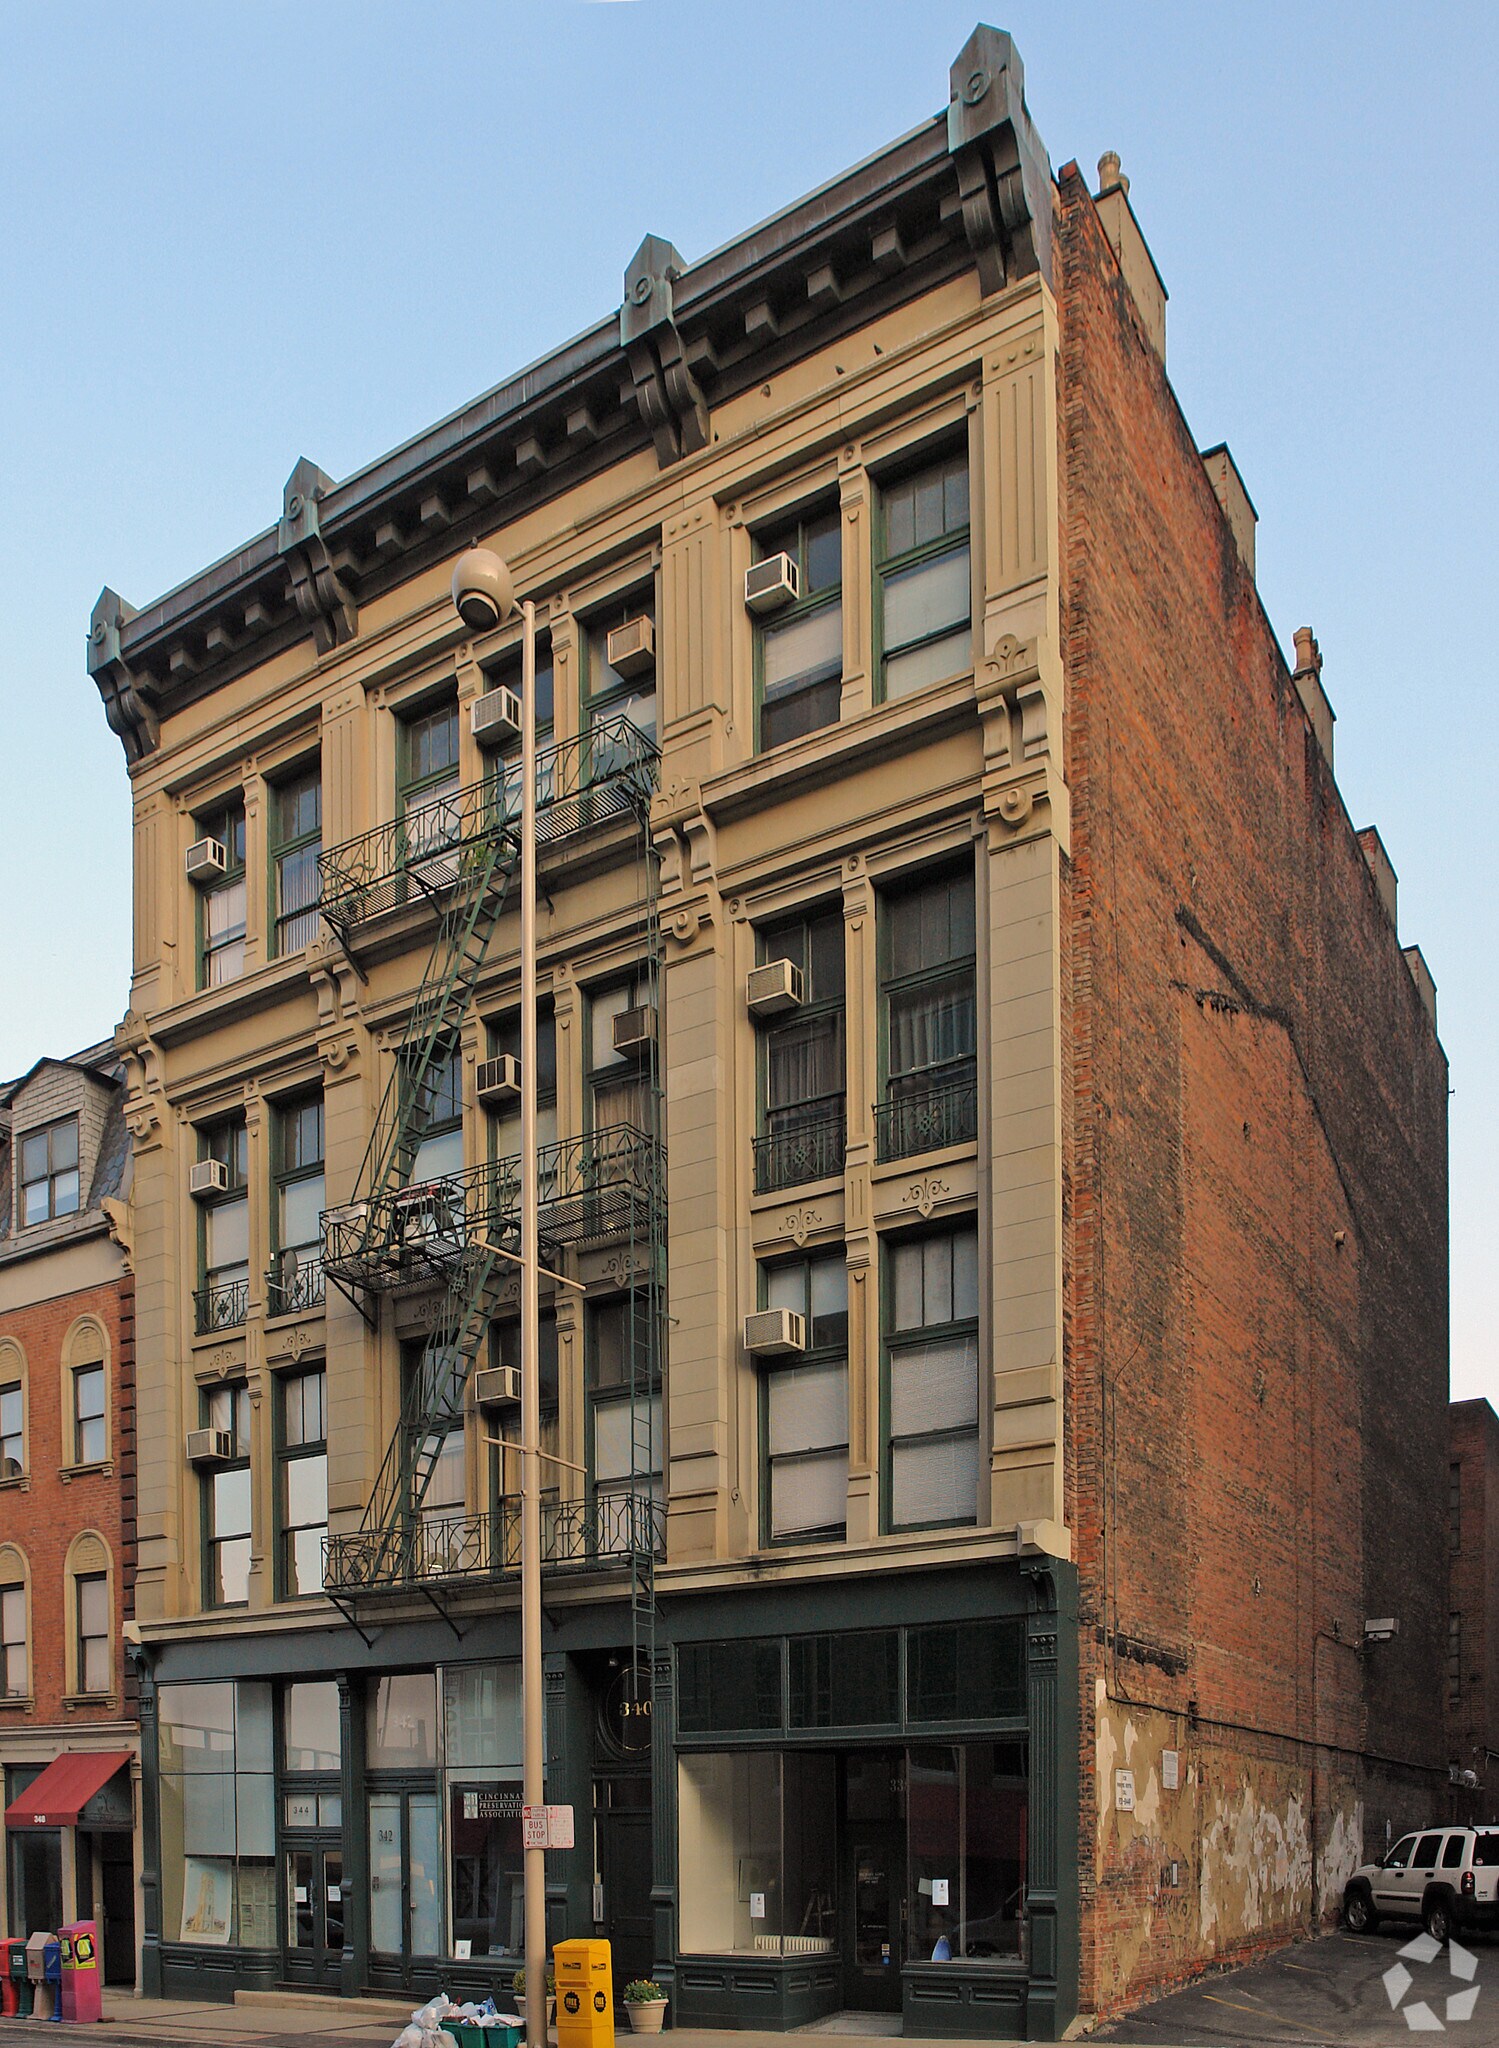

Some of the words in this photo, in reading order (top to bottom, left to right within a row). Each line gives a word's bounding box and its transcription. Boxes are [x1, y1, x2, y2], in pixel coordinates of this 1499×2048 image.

[619, 1701, 652, 1717] 340
[890, 1779, 907, 1792] 33
[293, 1806, 309, 1815] 344
[528, 1821, 543, 1829] BUS
[378, 1830, 393, 1842] 342
[527, 1831, 545, 1839] STOP
